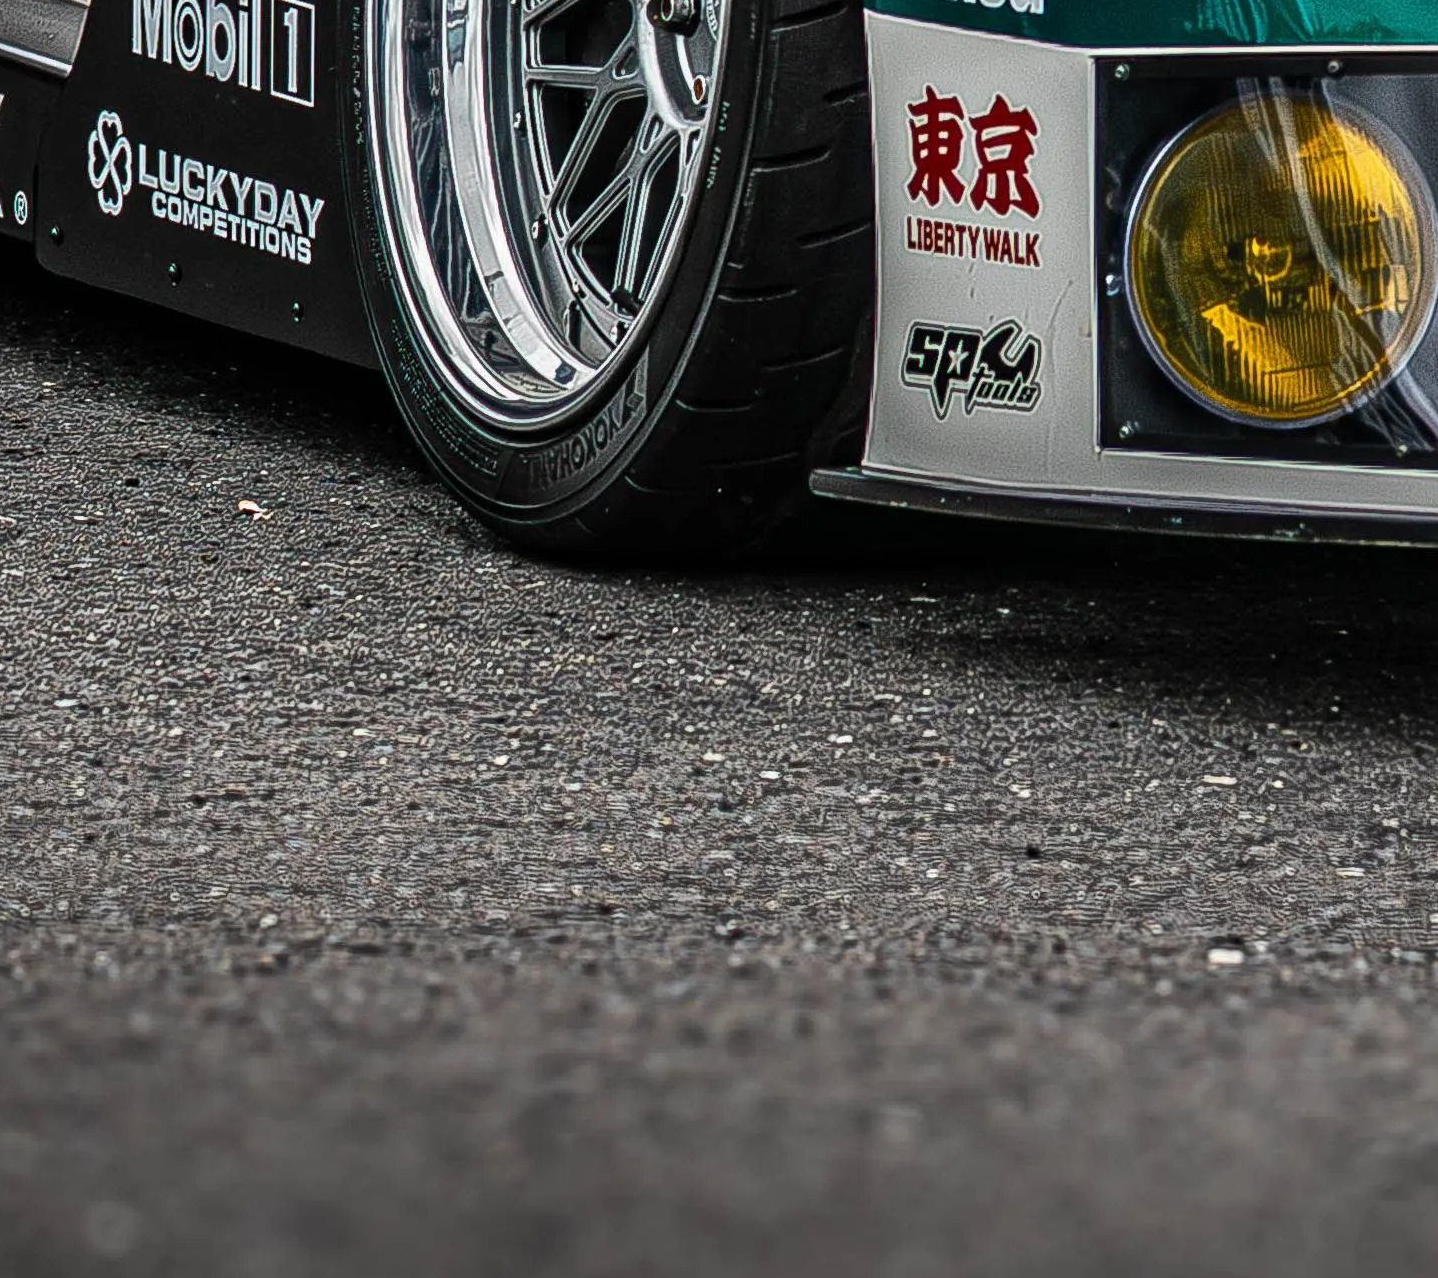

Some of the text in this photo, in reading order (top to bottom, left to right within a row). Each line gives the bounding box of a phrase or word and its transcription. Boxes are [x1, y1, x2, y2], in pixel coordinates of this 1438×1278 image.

[138, 142, 325, 240] LUCKYDAY
[907, 84, 1040, 220] 東京
[151, 191, 313, 266] COMPETITIONS
[906, 215, 1041, 268] LIBERTY WALK
